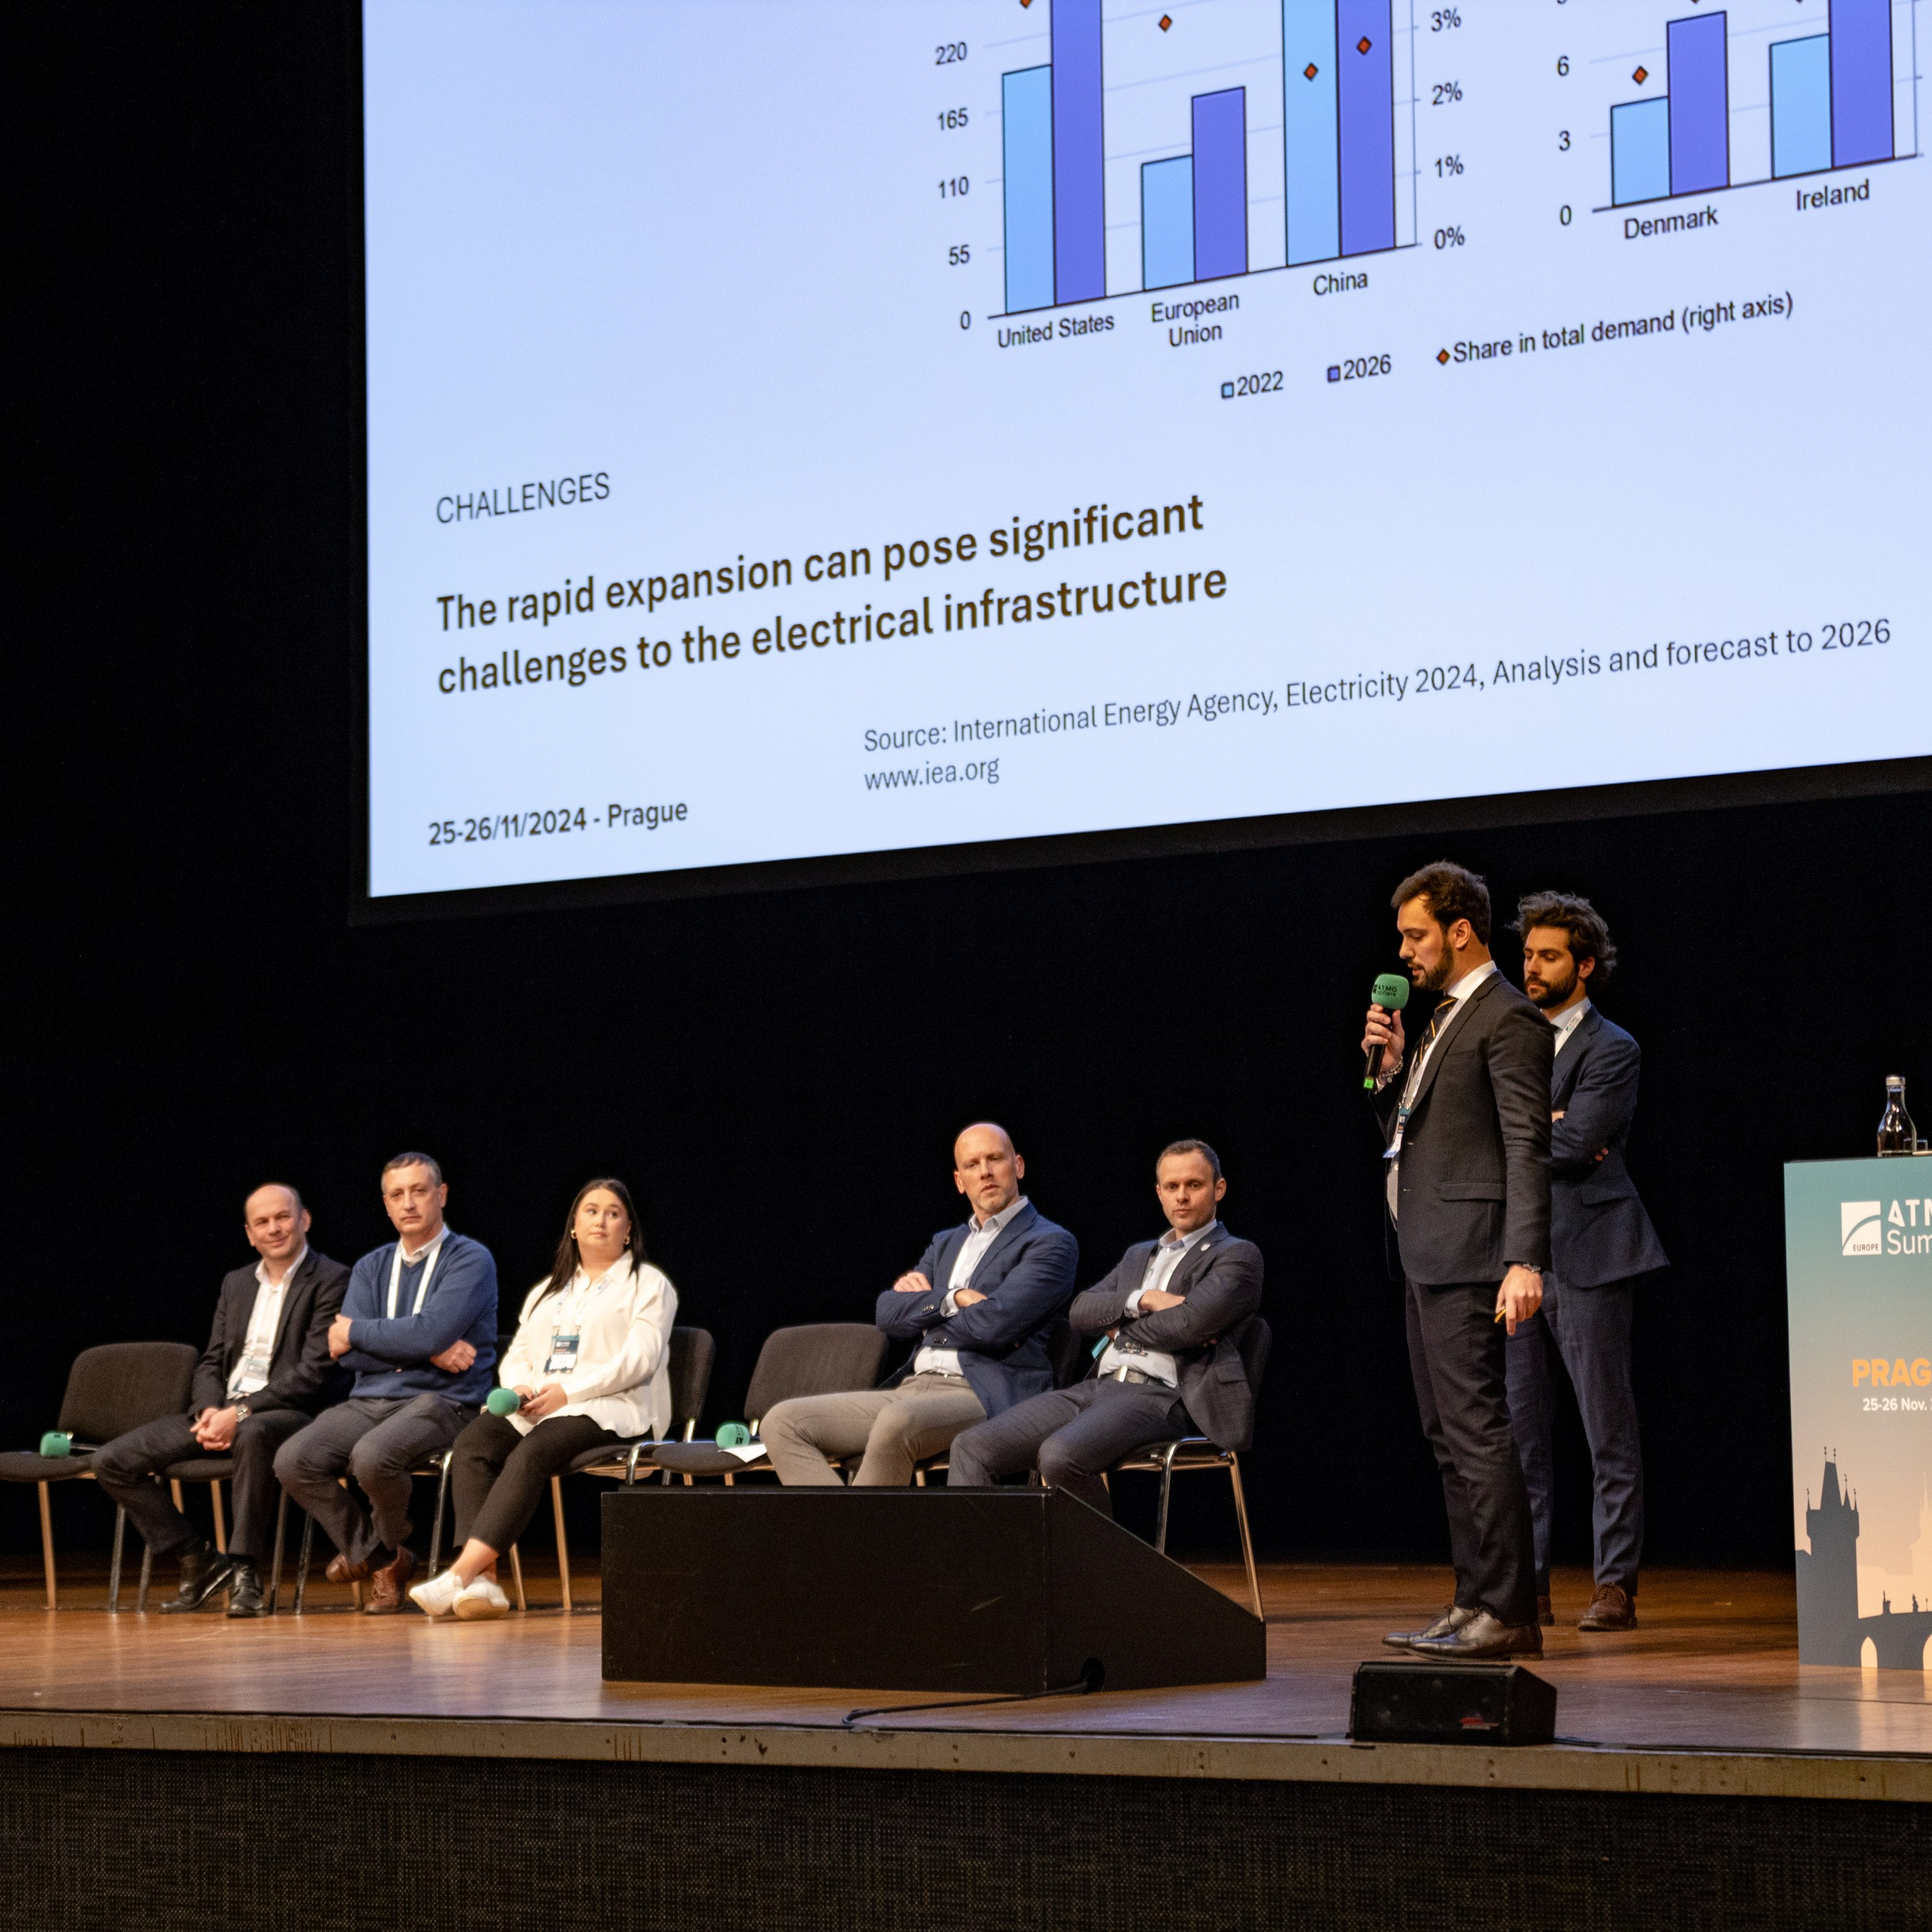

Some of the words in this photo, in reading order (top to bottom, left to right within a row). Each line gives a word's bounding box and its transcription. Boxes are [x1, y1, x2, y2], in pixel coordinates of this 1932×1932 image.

[1430, 8, 1462, 32] 3%
[935, 41, 968, 66] 220
[1556, 55, 1570, 77] 6
[1432, 81, 1463, 106] 2%
[937, 106, 969, 131] 165
[1558, 130, 1571, 152] 3
[1434, 154, 1465, 179] 1%
[938, 176, 970, 199] 110
[1796, 177, 1870, 211] Ireland
[1559, 204, 1573, 227] 0
[1623, 205, 1719, 240] Denmark
[1433, 225, 1466, 251] 0%
[949, 244, 971, 266] 55
[1312, 272, 1369, 297] China
[959, 310, 971, 331] 0
[1151, 294, 1240, 324] European
[997, 321, 1054, 349] United
[1058, 315, 1115, 339] States
[1168, 323, 1223, 348] Union
[1453, 340, 1514, 364] Share
[1518, 332, 1537, 354] in
[1541, 323, 1585, 350] total
[1591, 309, 1675, 343] demand
[1681, 300, 1737, 335] (right
[1741, 291, 1794, 320] axis)
[1343, 353, 1392, 381] 2026
[1237, 370, 1284, 397] 2022
[436, 472, 611, 525] CHALLENGES
[436, 593, 497, 632] The
[507, 574, 595, 628] rapid
[605, 554, 792, 614] expansion
[804, 547, 872, 583] can
[883, 533, 977, 582] pose
[989, 494, 1204, 563] significant
[438, 646, 628, 695] challenges
[635, 636, 672, 670] to
[681, 625, 741, 664] the
[752, 595, 934, 656] electrical
[944, 569, 1227, 632] infrastructure
[864, 727, 946, 752] Source:
[954, 705, 1098, 743] International
[1104, 699, 1182, 727] Energy
[1186, 690, 1278, 722] Agency,
[1287, 670, 1409, 707] Electricity
[1415, 663, 1484, 694] 2024,
[1492, 648, 1601, 685] Analysis
[1609, 643, 1658, 672] and
[1666, 631, 1779, 666] forecast
[1785, 629, 1813, 654] to
[1821, 618, 1891, 651] 2026
[864, 758, 1000, 791] www.iea.org
[429, 807, 587, 847] 25-26/11/2024
[608, 802, 688, 832] Prague
[1377, 984, 1397, 992] ATMO
[1853, 1244, 1879, 1252] EUROPE
[1852, 1358, 1932, 1387] PRAG
[1863, 1398, 1898, 1411] 25-26
[1901, 1398, 1927, 1411] Nov.
